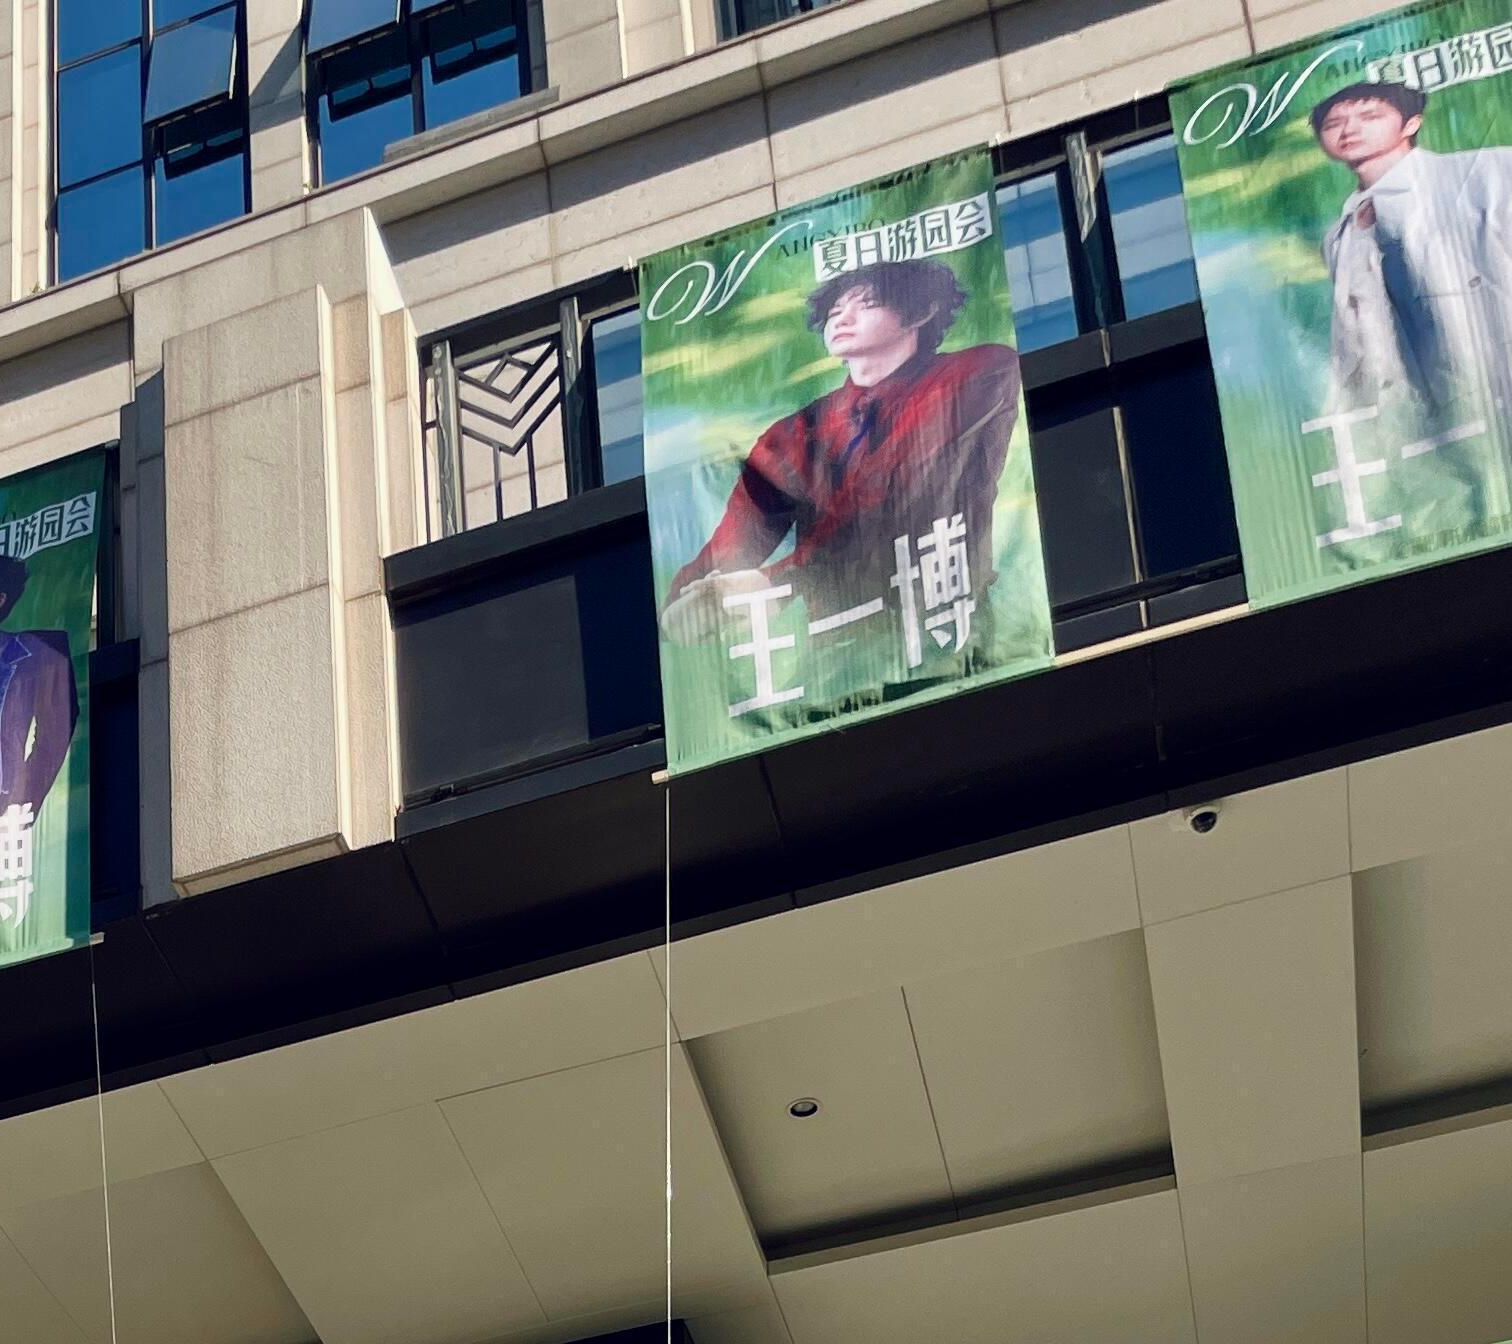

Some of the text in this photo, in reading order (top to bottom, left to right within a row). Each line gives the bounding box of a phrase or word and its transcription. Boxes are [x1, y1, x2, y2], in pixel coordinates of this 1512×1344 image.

[819, 200, 987, 275] 夏日游园会
[723, 512, 975, 718] 王一博
